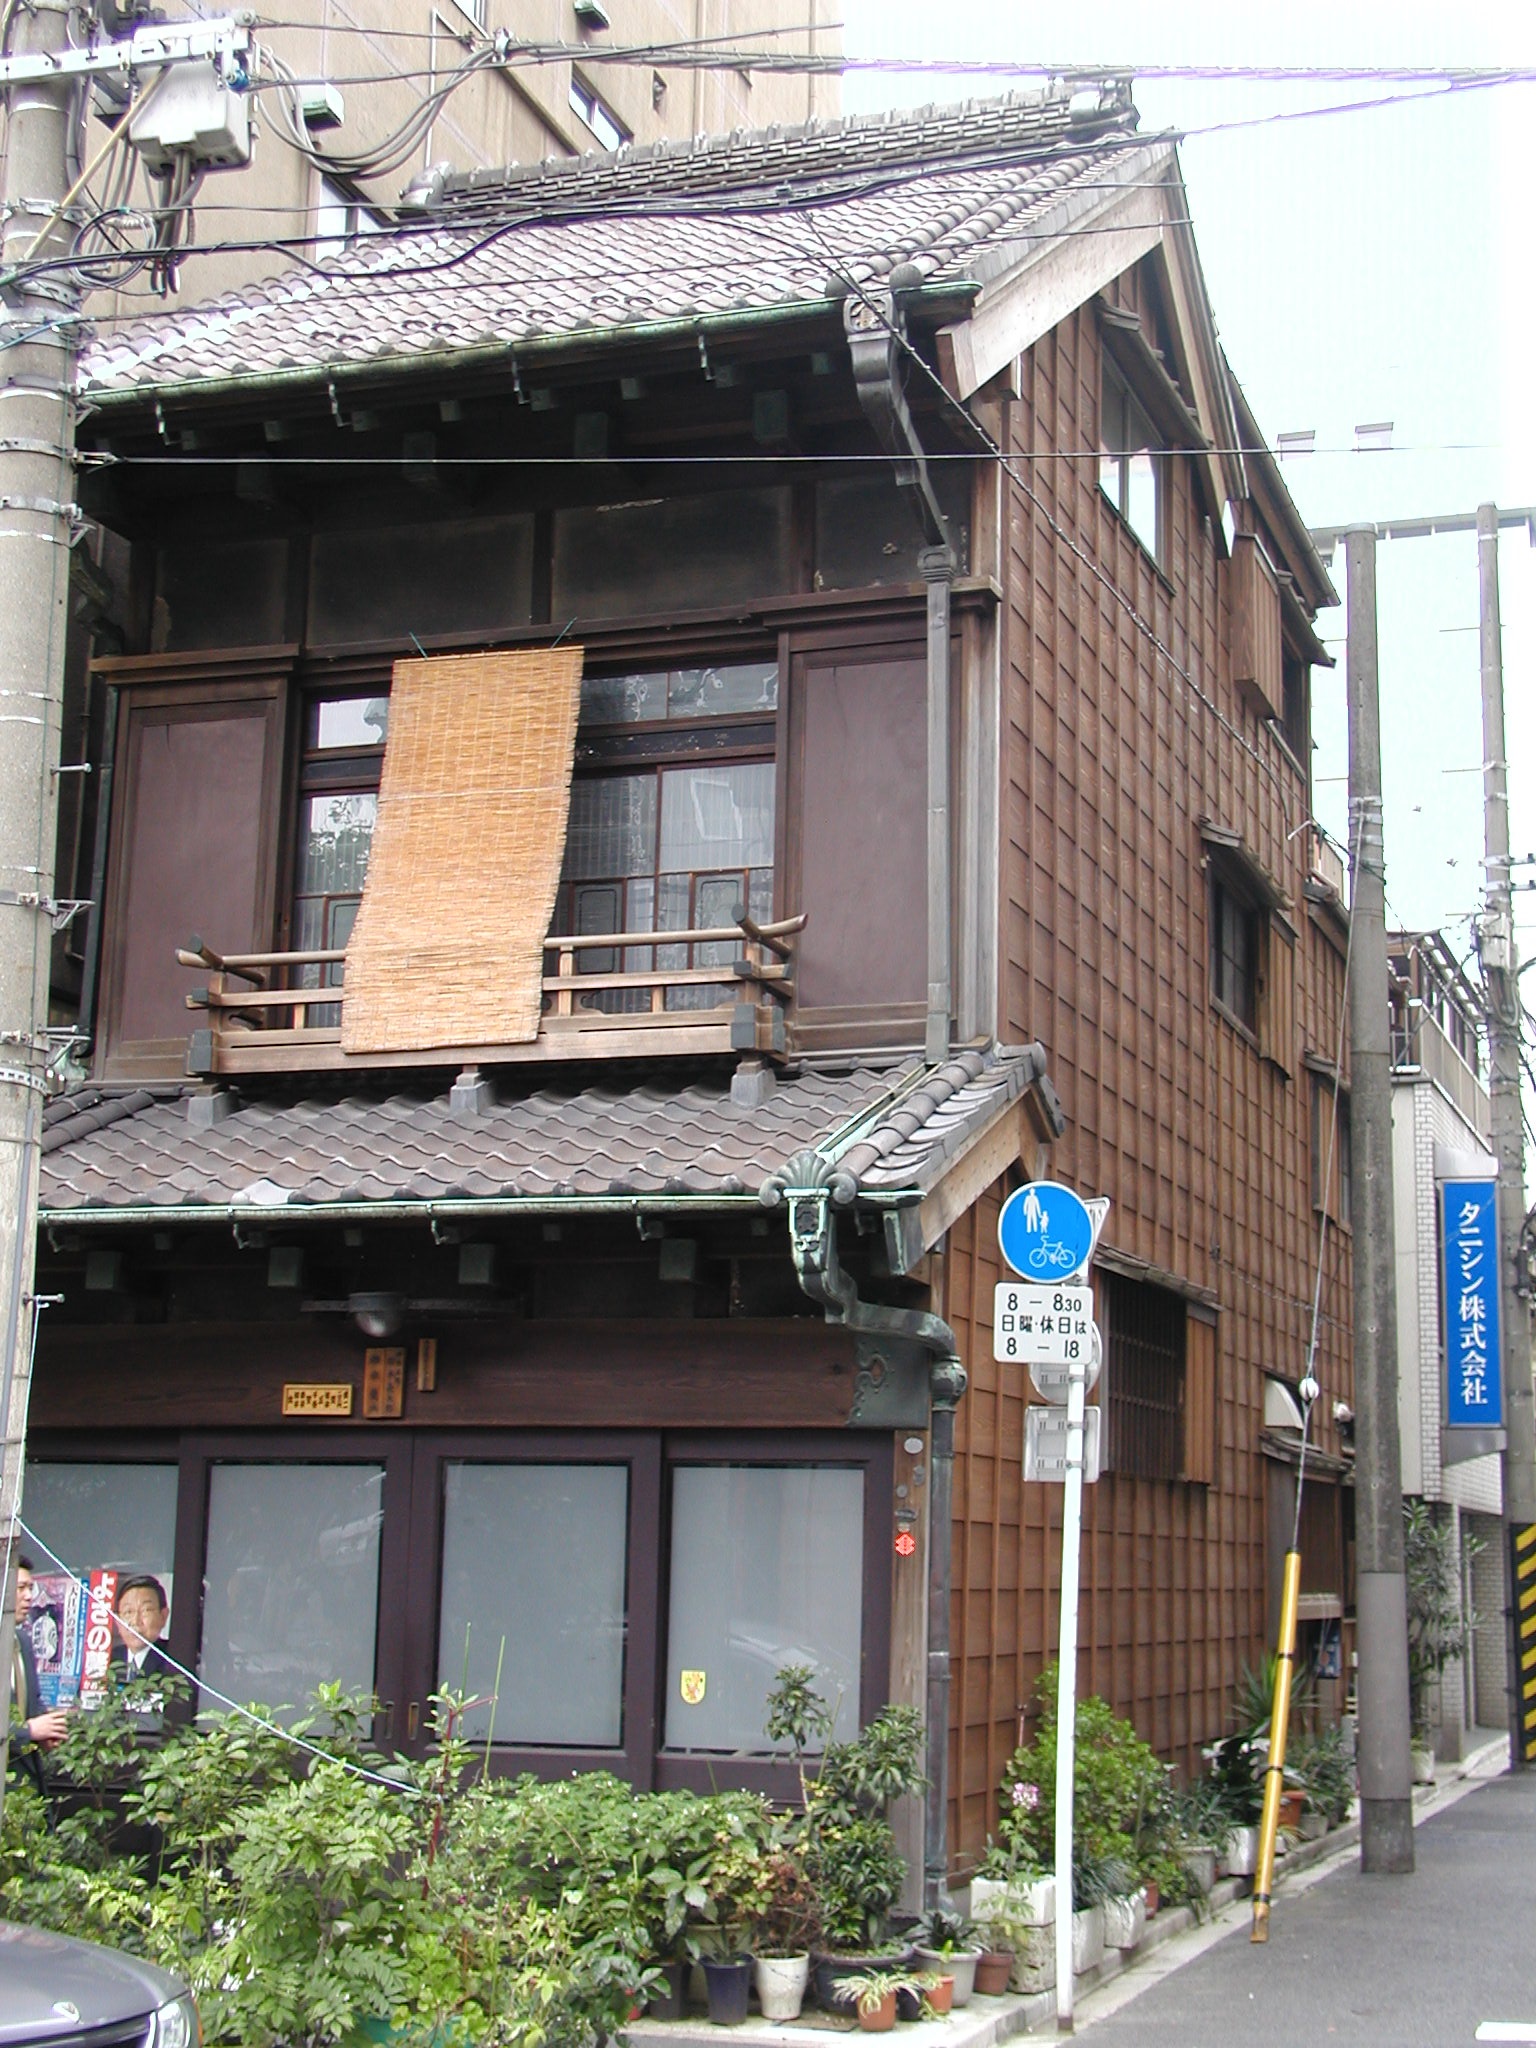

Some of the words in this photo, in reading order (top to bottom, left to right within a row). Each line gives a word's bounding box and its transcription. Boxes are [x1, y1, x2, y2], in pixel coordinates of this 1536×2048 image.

[1007, 1292, 1018, 1311] 8
[1457, 1201, 1488, 1406] タニシン株式会社
[1006, 1337, 1017, 1356] 8
[1064, 1339, 1080, 1359] 18
